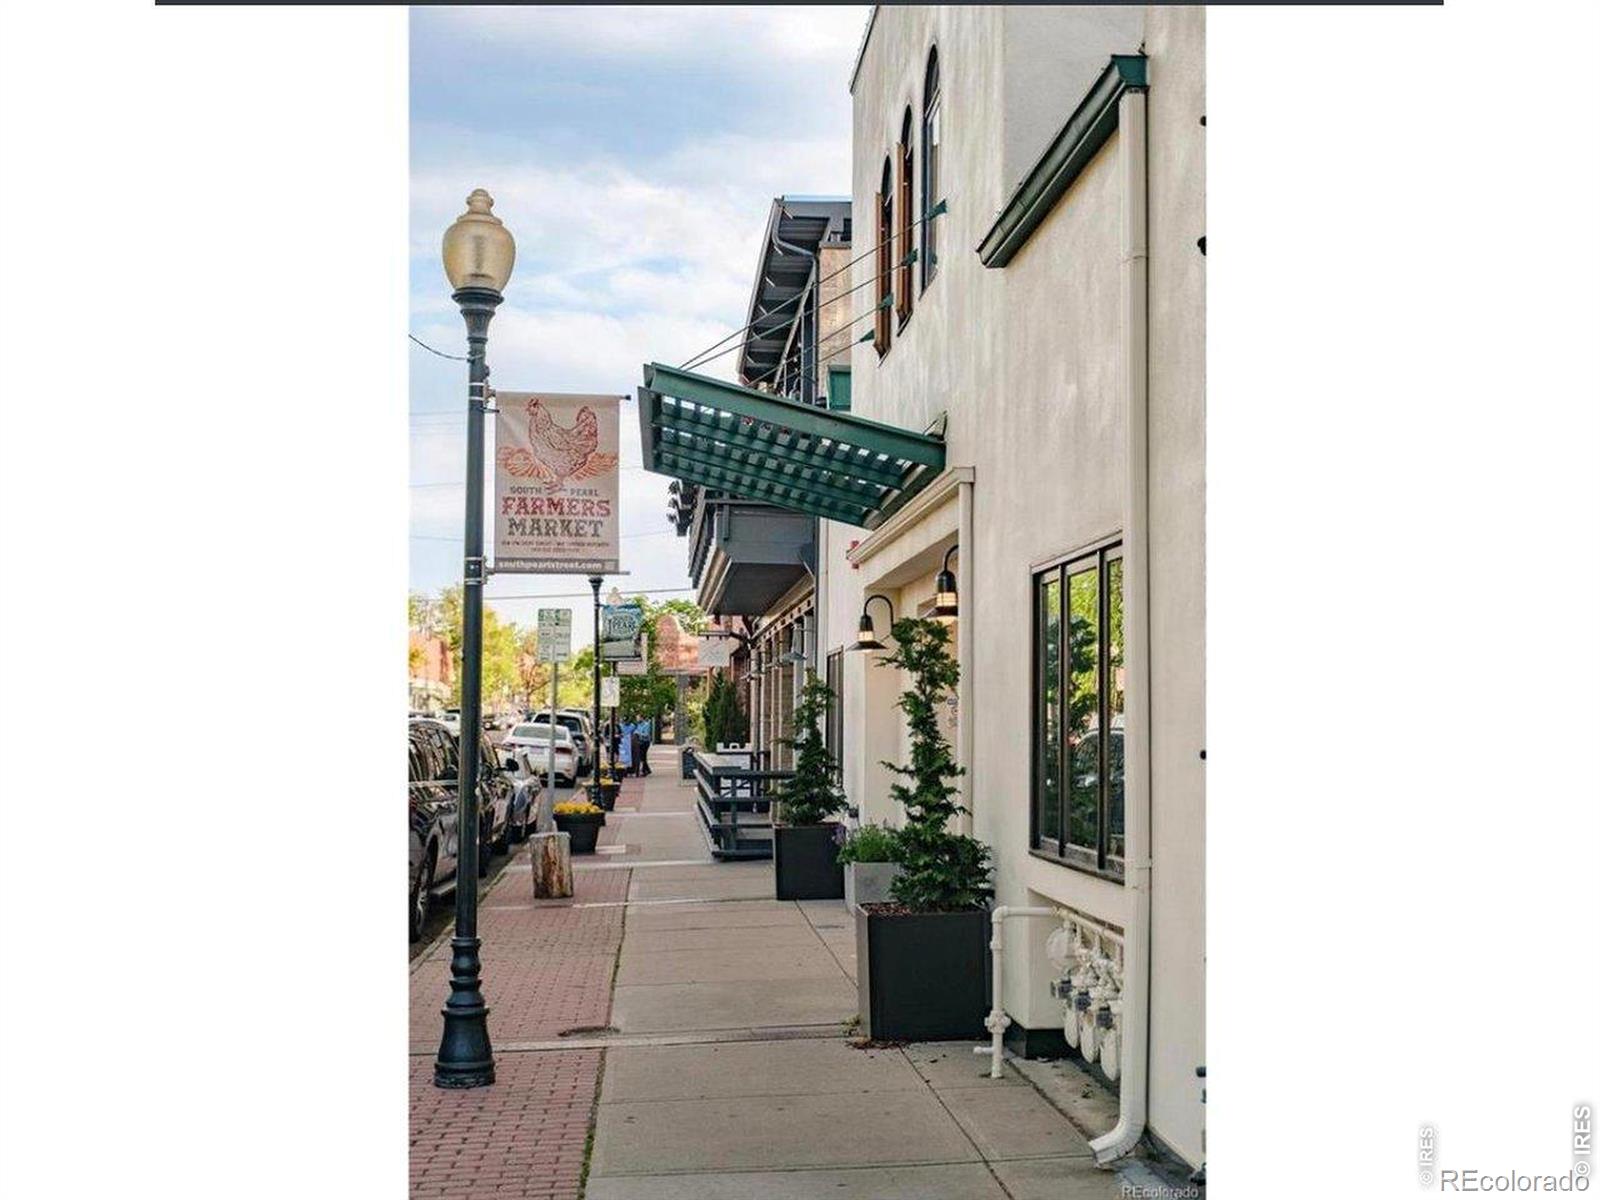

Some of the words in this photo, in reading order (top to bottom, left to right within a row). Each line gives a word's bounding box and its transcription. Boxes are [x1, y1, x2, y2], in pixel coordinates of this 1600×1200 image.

[510, 486, 542, 495] SOUTH
[570, 488, 599, 497] PEARL
[502, 496, 611, 517] FARMERS
[508, 518, 604, 537] MARKET
[499, 560, 603, 571] southpearlstreet.com
